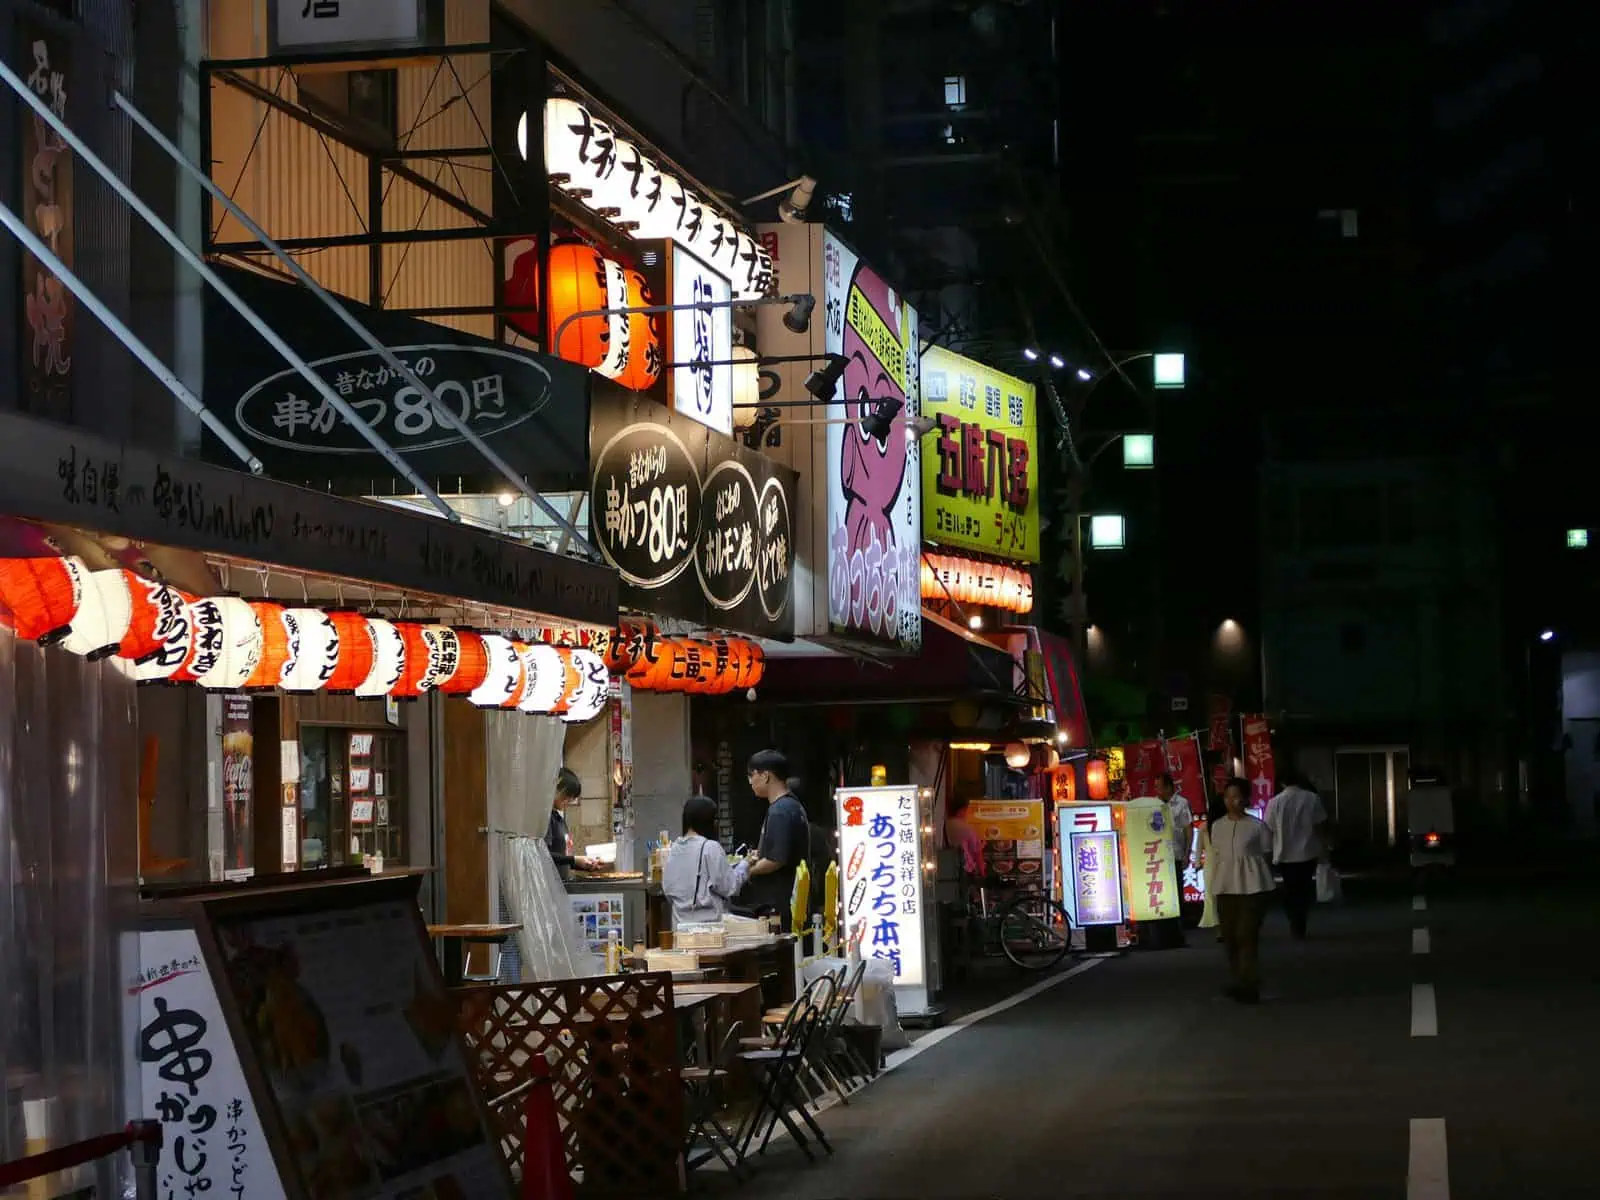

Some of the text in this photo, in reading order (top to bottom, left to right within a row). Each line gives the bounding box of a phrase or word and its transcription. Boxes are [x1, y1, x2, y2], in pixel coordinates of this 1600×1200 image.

[630, 444, 667, 489] 昔ながらの
[716, 465, 740, 523] なにわの
[705, 521, 754, 580] ホルモン焼
[995, 512, 1027, 551] ラーメン
[897, 795, 915, 843] たこ焼
[899, 851, 917, 915] 発祥の店
